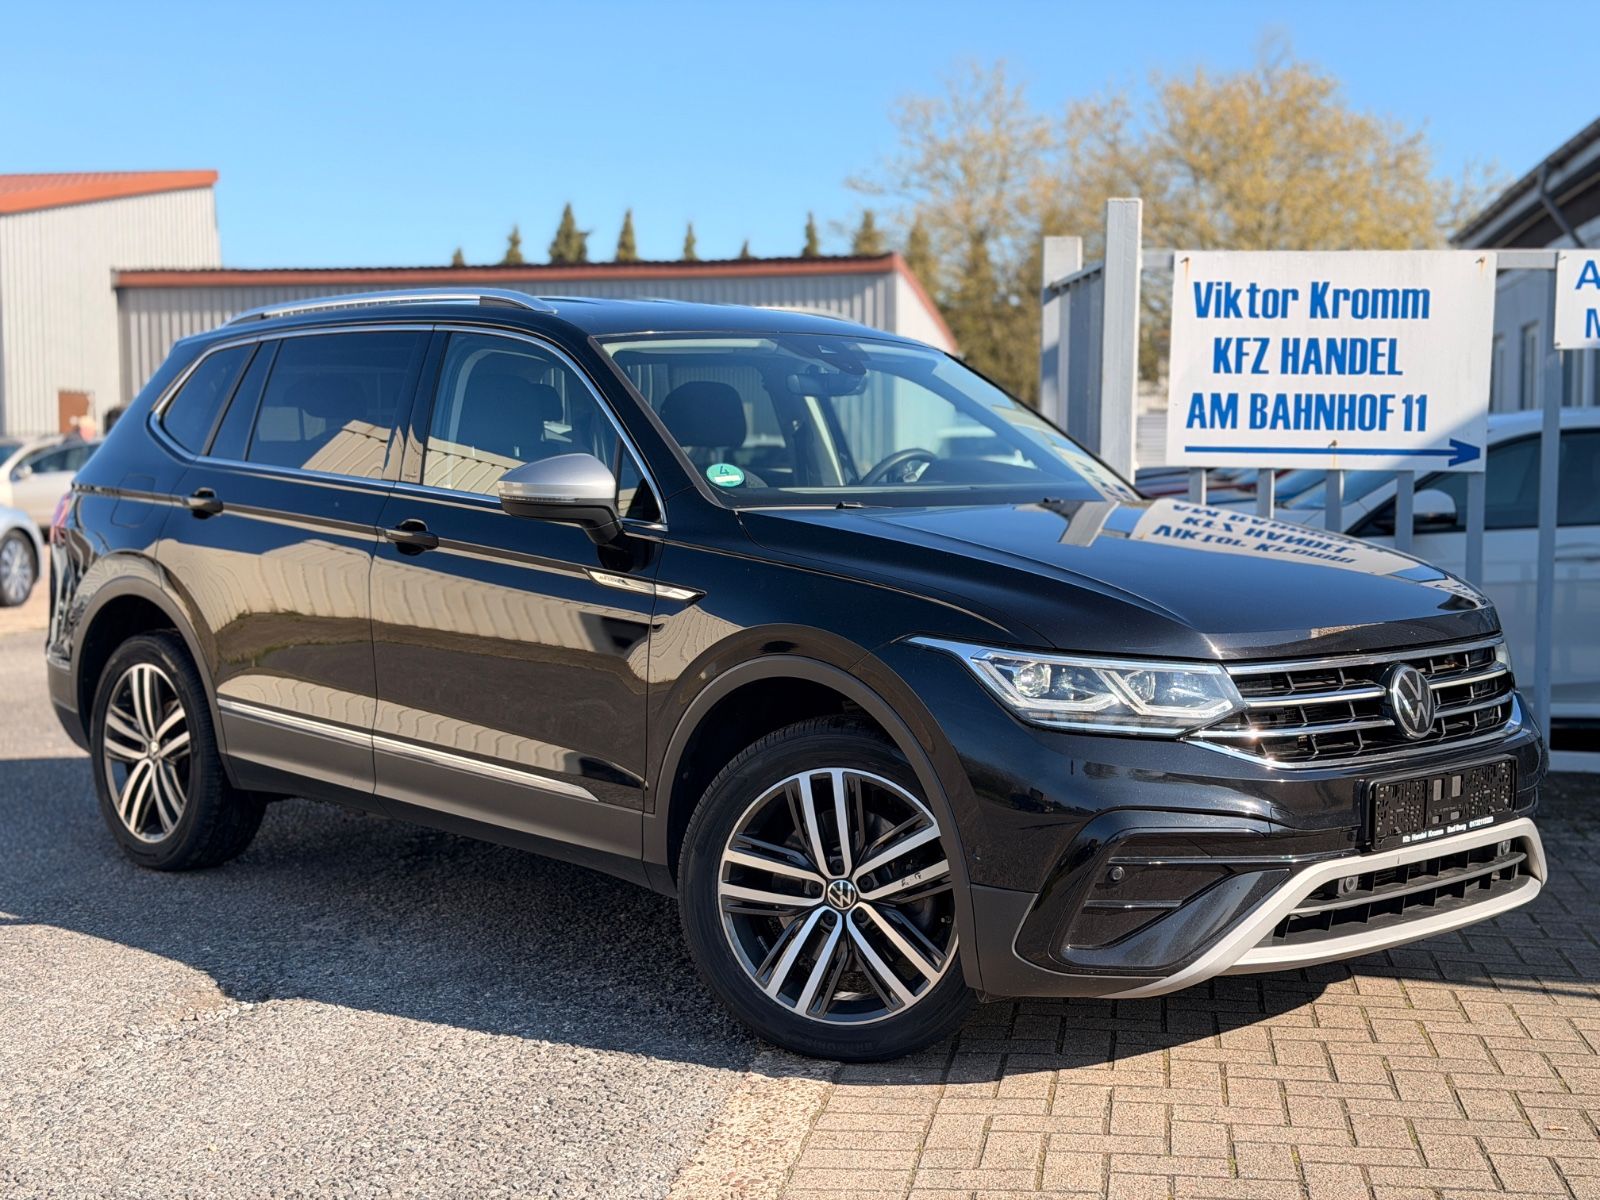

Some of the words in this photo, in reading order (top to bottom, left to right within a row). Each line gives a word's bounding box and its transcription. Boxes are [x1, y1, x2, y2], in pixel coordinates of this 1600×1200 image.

[1193, 281, 1299, 319] Viktor
[1309, 281, 1431, 320] Kromm
[1212, 336, 1270, 375] KFZ
[1279, 337, 1403, 376] HANDEL
[1186, 392, 1239, 429] AM
[1248, 393, 1396, 432] BAHNHOF
[1401, 394, 1428, 432] 11
[719, 465, 730, 475] 4
